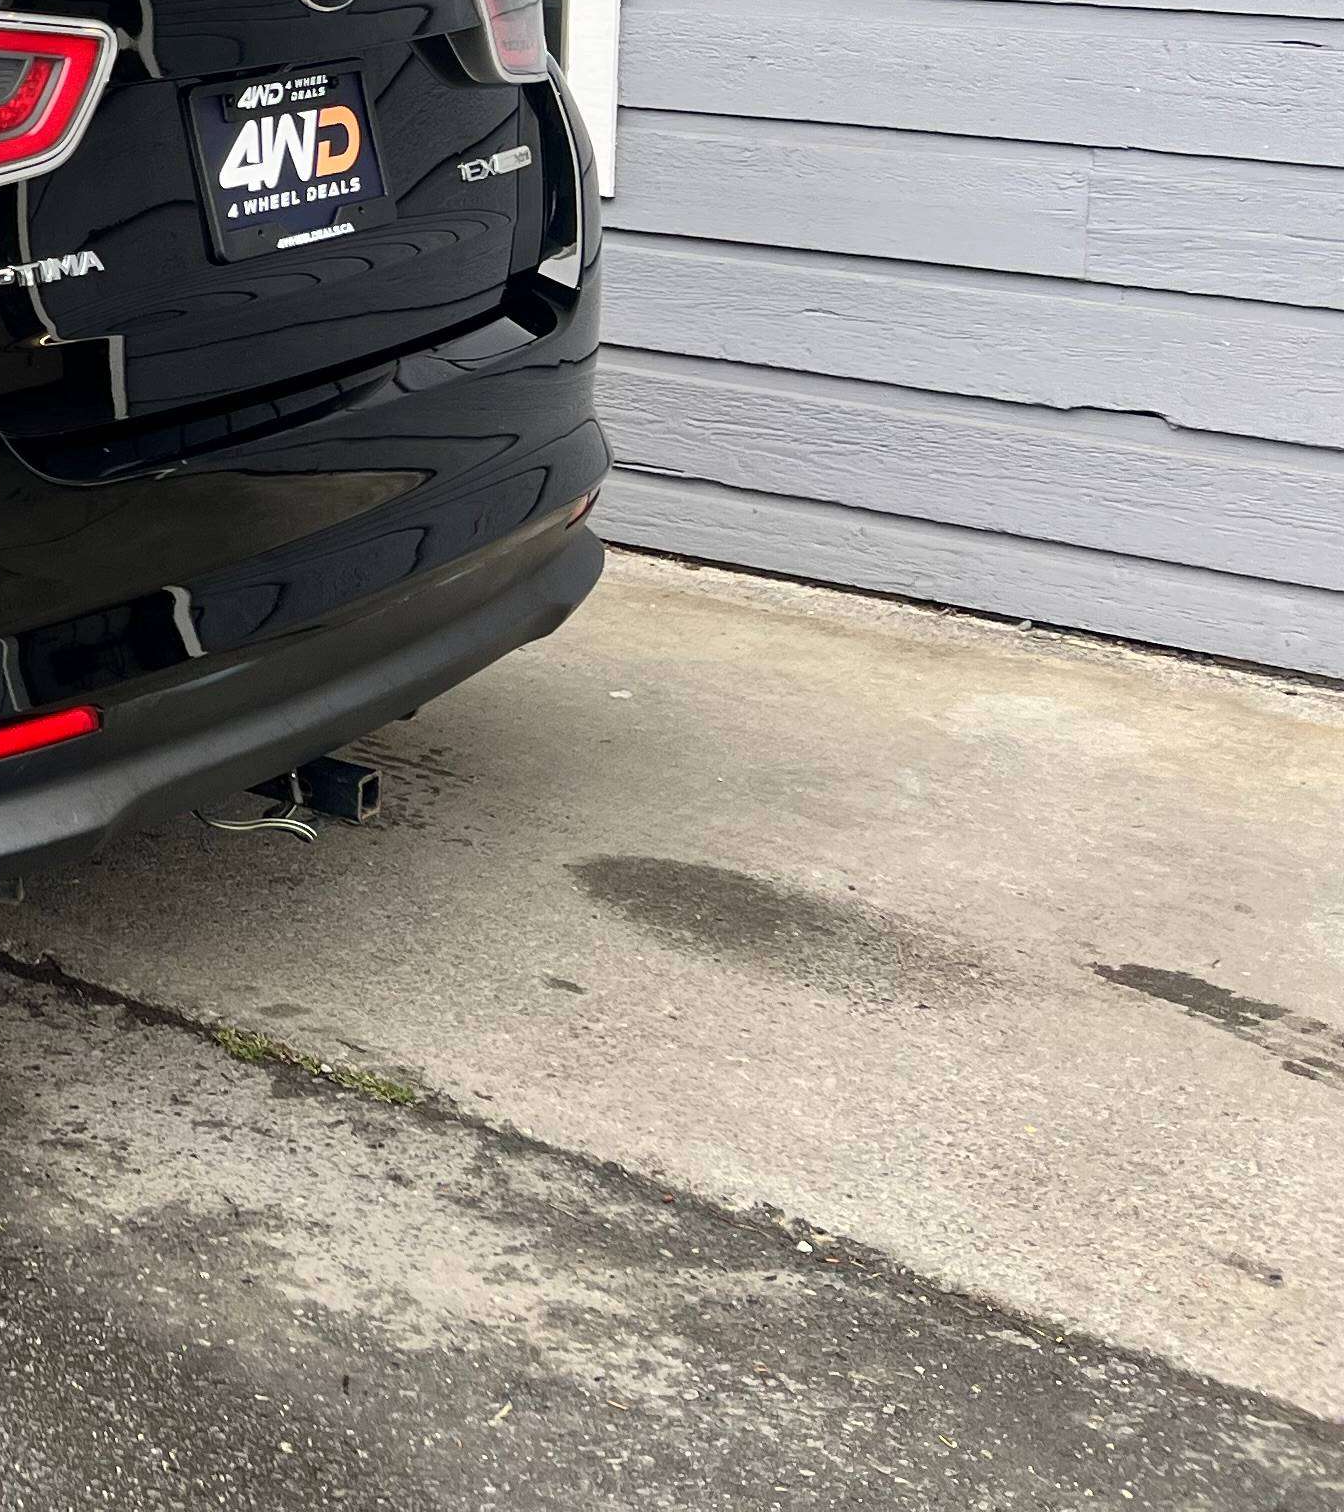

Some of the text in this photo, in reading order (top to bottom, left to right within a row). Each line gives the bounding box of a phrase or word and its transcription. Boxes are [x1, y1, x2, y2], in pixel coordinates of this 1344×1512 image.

[237, 82, 284, 109] 4WD
[285, 74, 329, 90] 4 WHEEL
[290, 86, 326, 102] DEALS
[218, 104, 361, 192] 4WD
[227, 176, 362, 219] 4 WHEEL DEALS
